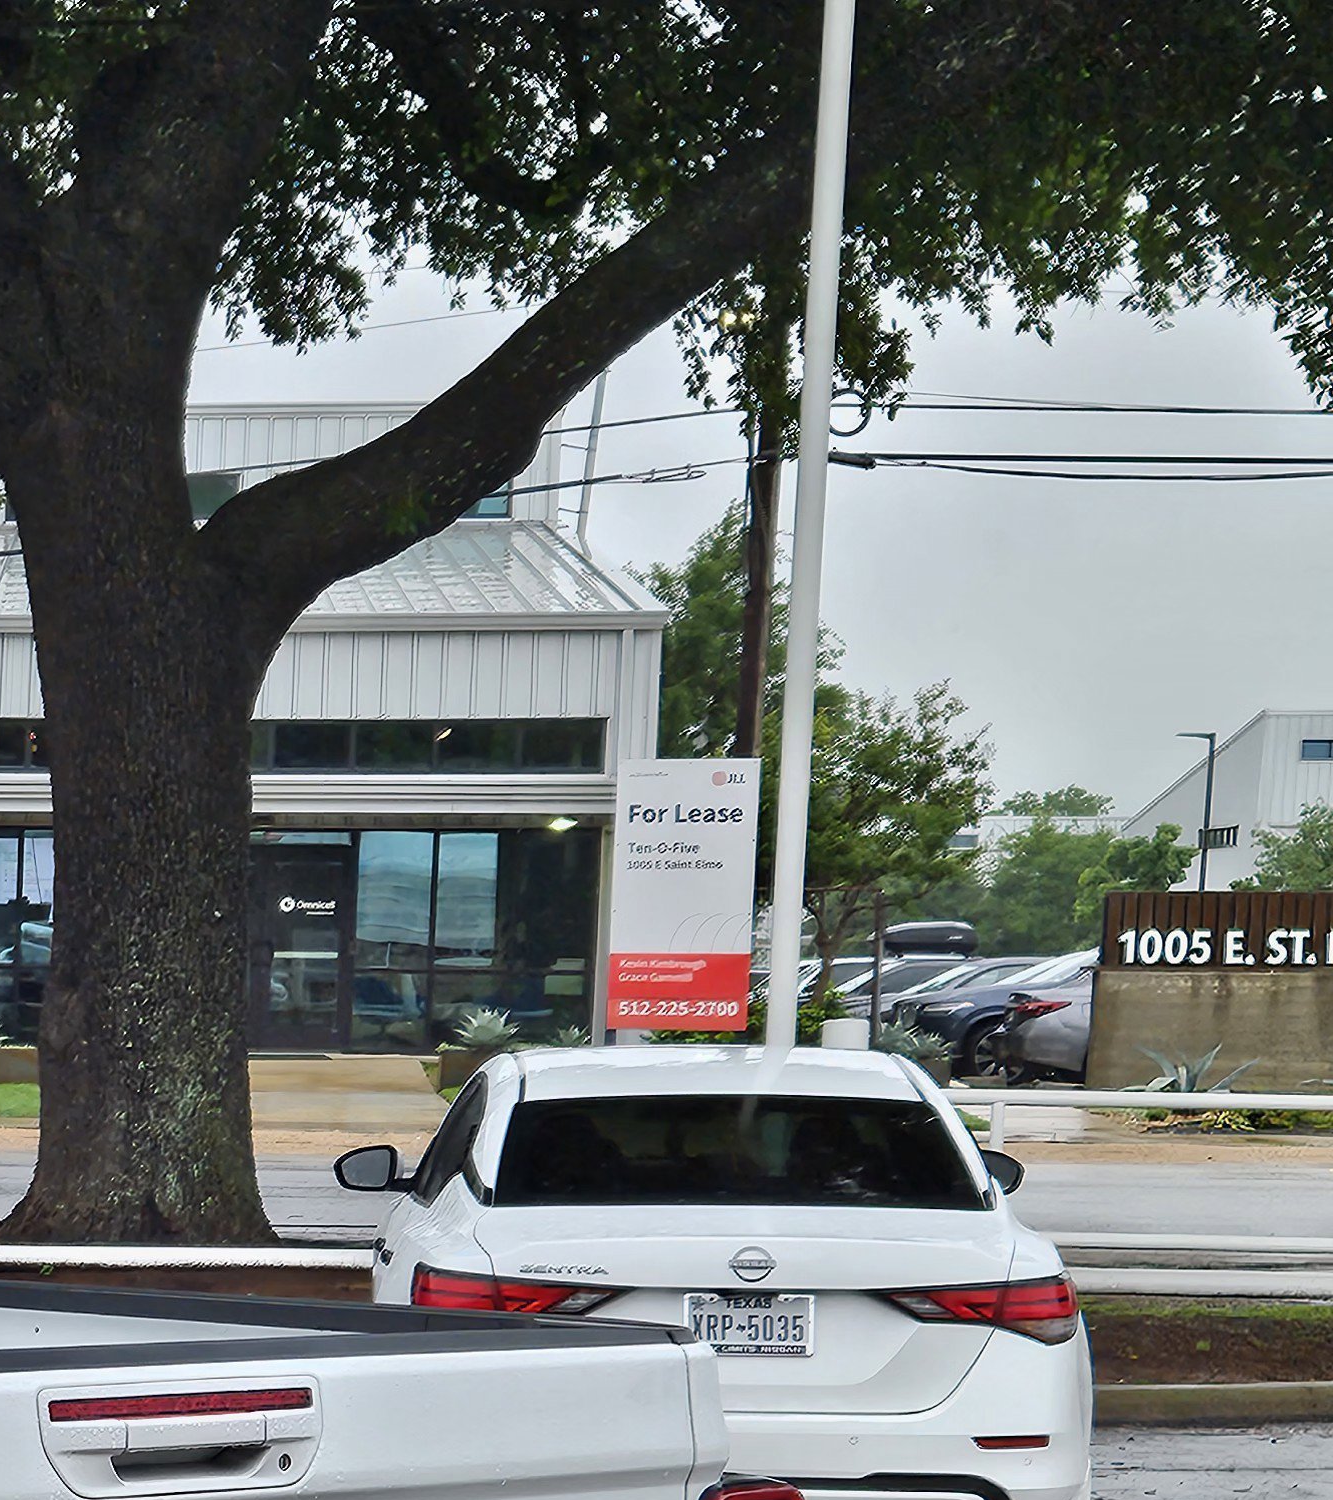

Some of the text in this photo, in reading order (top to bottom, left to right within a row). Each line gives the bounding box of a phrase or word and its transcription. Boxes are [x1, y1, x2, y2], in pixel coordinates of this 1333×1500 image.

[628, 803, 744, 824] For Lease
[664, 859, 692, 870] Saint
[1117, 927, 1212, 966] 1005
[1223, 928, 1256, 966] E.
[1264, 927, 1318, 966] ST.
[618, 1001, 740, 1017] 512-225-2700
[519, 1264, 609, 1275] SENTRA
[726, 1298, 773, 1309] TEXAS
